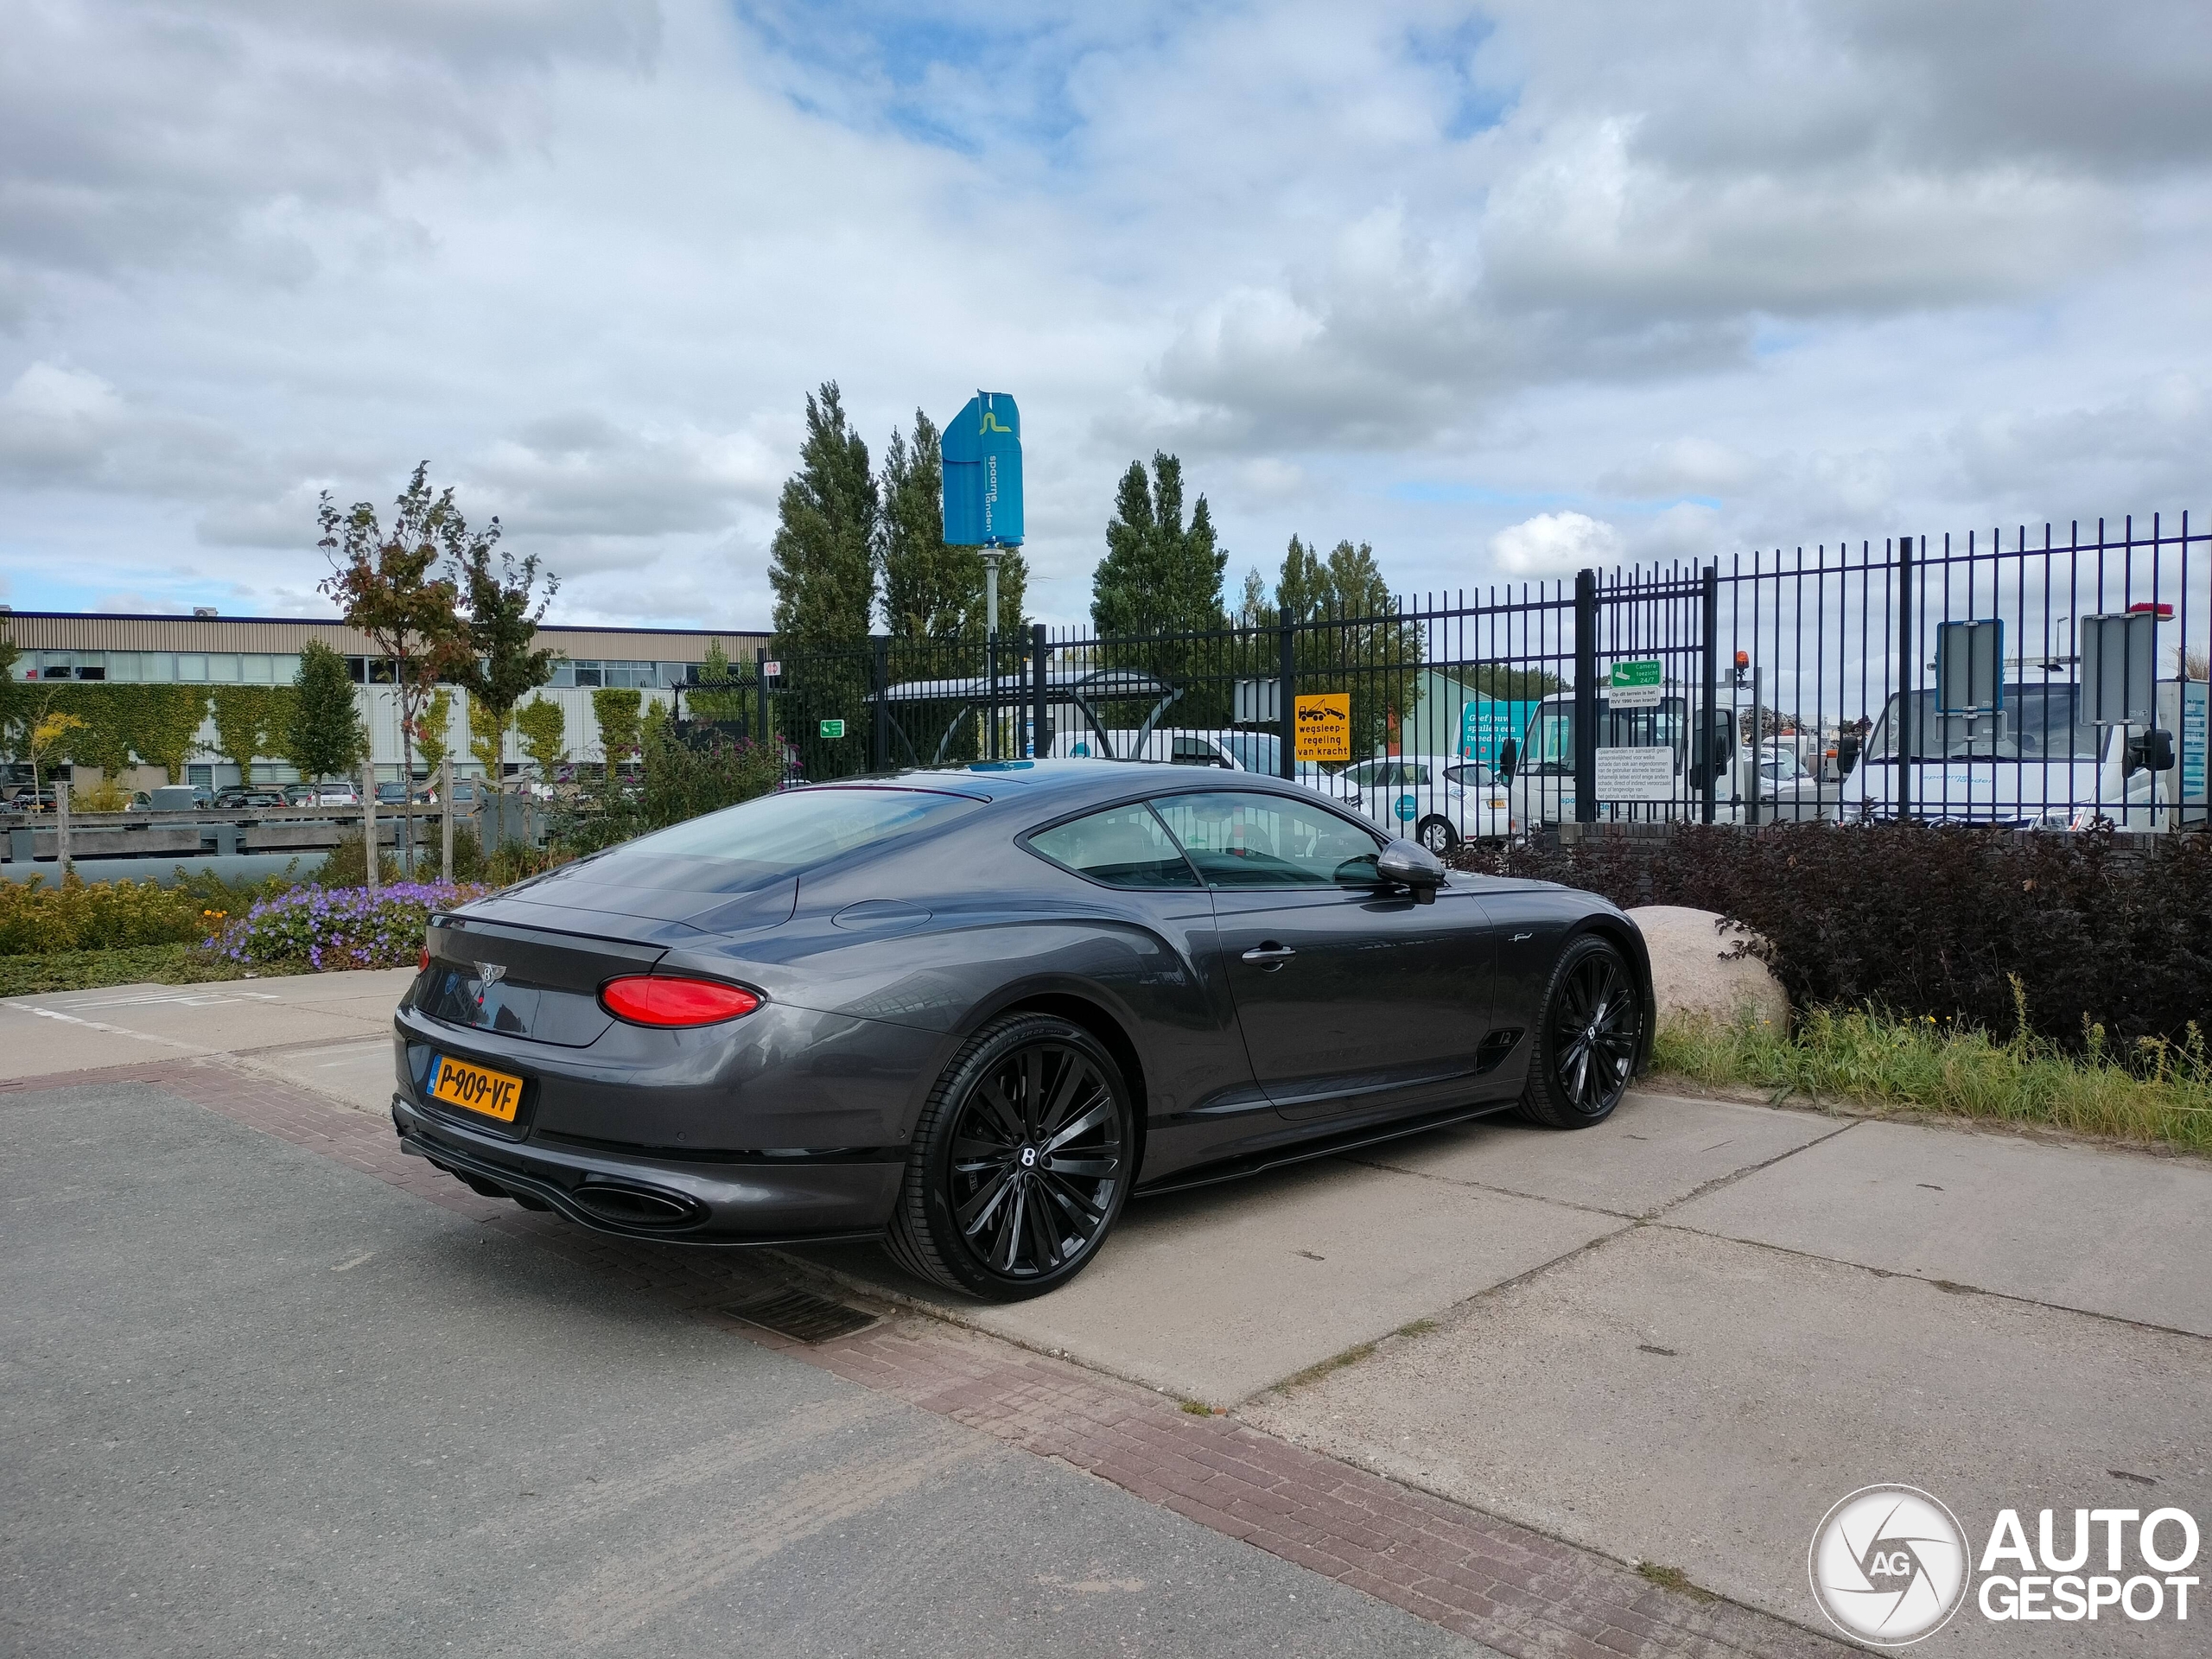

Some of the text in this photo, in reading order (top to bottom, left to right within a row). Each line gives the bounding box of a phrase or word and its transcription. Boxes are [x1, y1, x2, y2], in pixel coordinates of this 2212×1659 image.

[988, 455, 997, 502] spaarne
[1469, 714, 1490, 722] Gef
[1299, 724, 1345, 735] wegsleep-
[1304, 735, 1341, 747] regeling
[1497, 734, 1522, 743] len
[1317, 747, 1348, 756] kracht
[439, 1064, 516, 1112] P-909-VF
[1020, 1147, 1036, 1166] B
